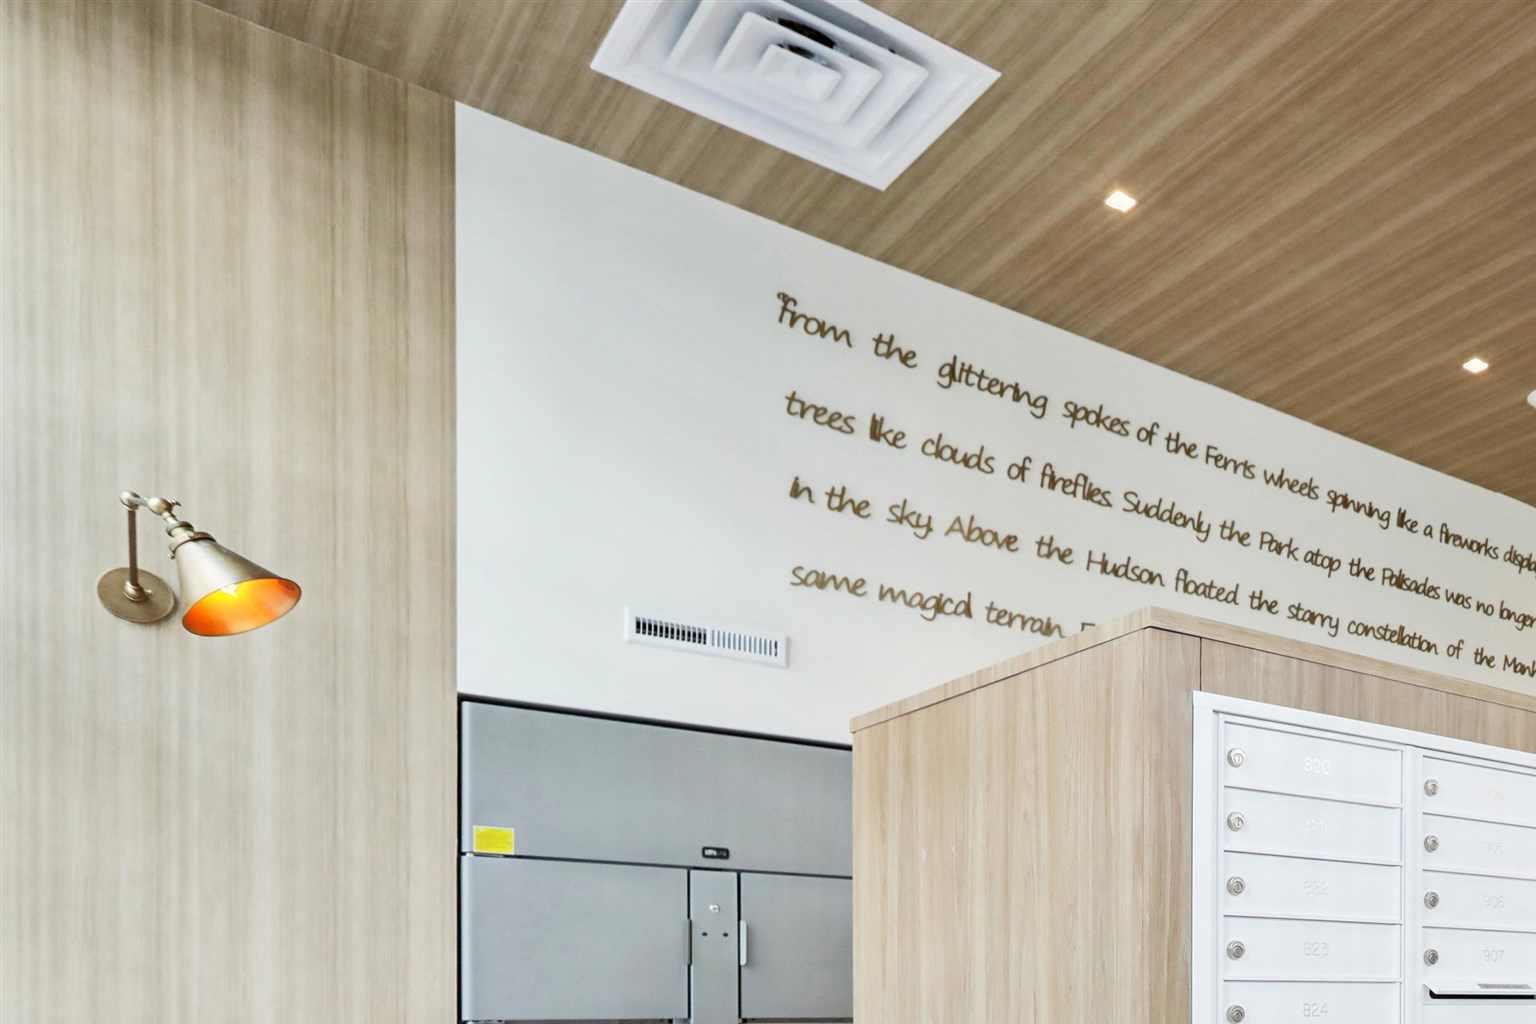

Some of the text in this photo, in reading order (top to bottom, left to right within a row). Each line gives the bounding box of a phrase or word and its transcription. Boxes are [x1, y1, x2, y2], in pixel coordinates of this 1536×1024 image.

[872, 333, 917, 368] the
[937, 355, 1048, 419] glittering
[1062, 401, 1130, 437] spokes
[1136, 422, 1159, 446] of
[1165, 432, 1198, 459] the
[1205, 445, 1255, 479] Ferris
[1264, 468, 1319, 500] wheels
[1327, 490, 1391, 530] spinning
[1396, 507, 1418, 533] like
[1423, 525, 1433, 538] a
[1440, 523, 1499, 559] fireworks
[785, 391, 855, 434] trees
[869, 413, 906, 449] like
[921, 433, 995, 474] clouds
[1007, 456, 1032, 483] of
[1123, 491, 1211, 543] Suddenly
[1219, 520, 1251, 547] the
[1260, 531, 1299, 561] Park
[1304, 549, 1341, 578] atop
[1348, 558, 1375, 581] the
[1382, 568, 1440, 600] Palisades
[1445, 589, 1472, 609] was
[1476, 601, 1494, 616] no
[791, 566, 867, 597] same
[879, 584, 972, 621] magical
[825, 486, 871, 518] the
[945, 515, 1019, 552] Above
[1036, 536, 1073, 564] the
[1086, 550, 1165, 587] Hudson
[1175, 568, 1239, 605] floated
[1249, 590, 1279, 615] the
[1287, 603, 1339, 637] starry
[1347, 620, 1438, 655] constellation
[1447, 639, 1464, 659] of
[1474, 647, 1495, 668] the
[1303, 942, 1330, 956] 823
[1483, 950, 1505, 961] 907
[1303, 1003, 1329, 1017] 824
